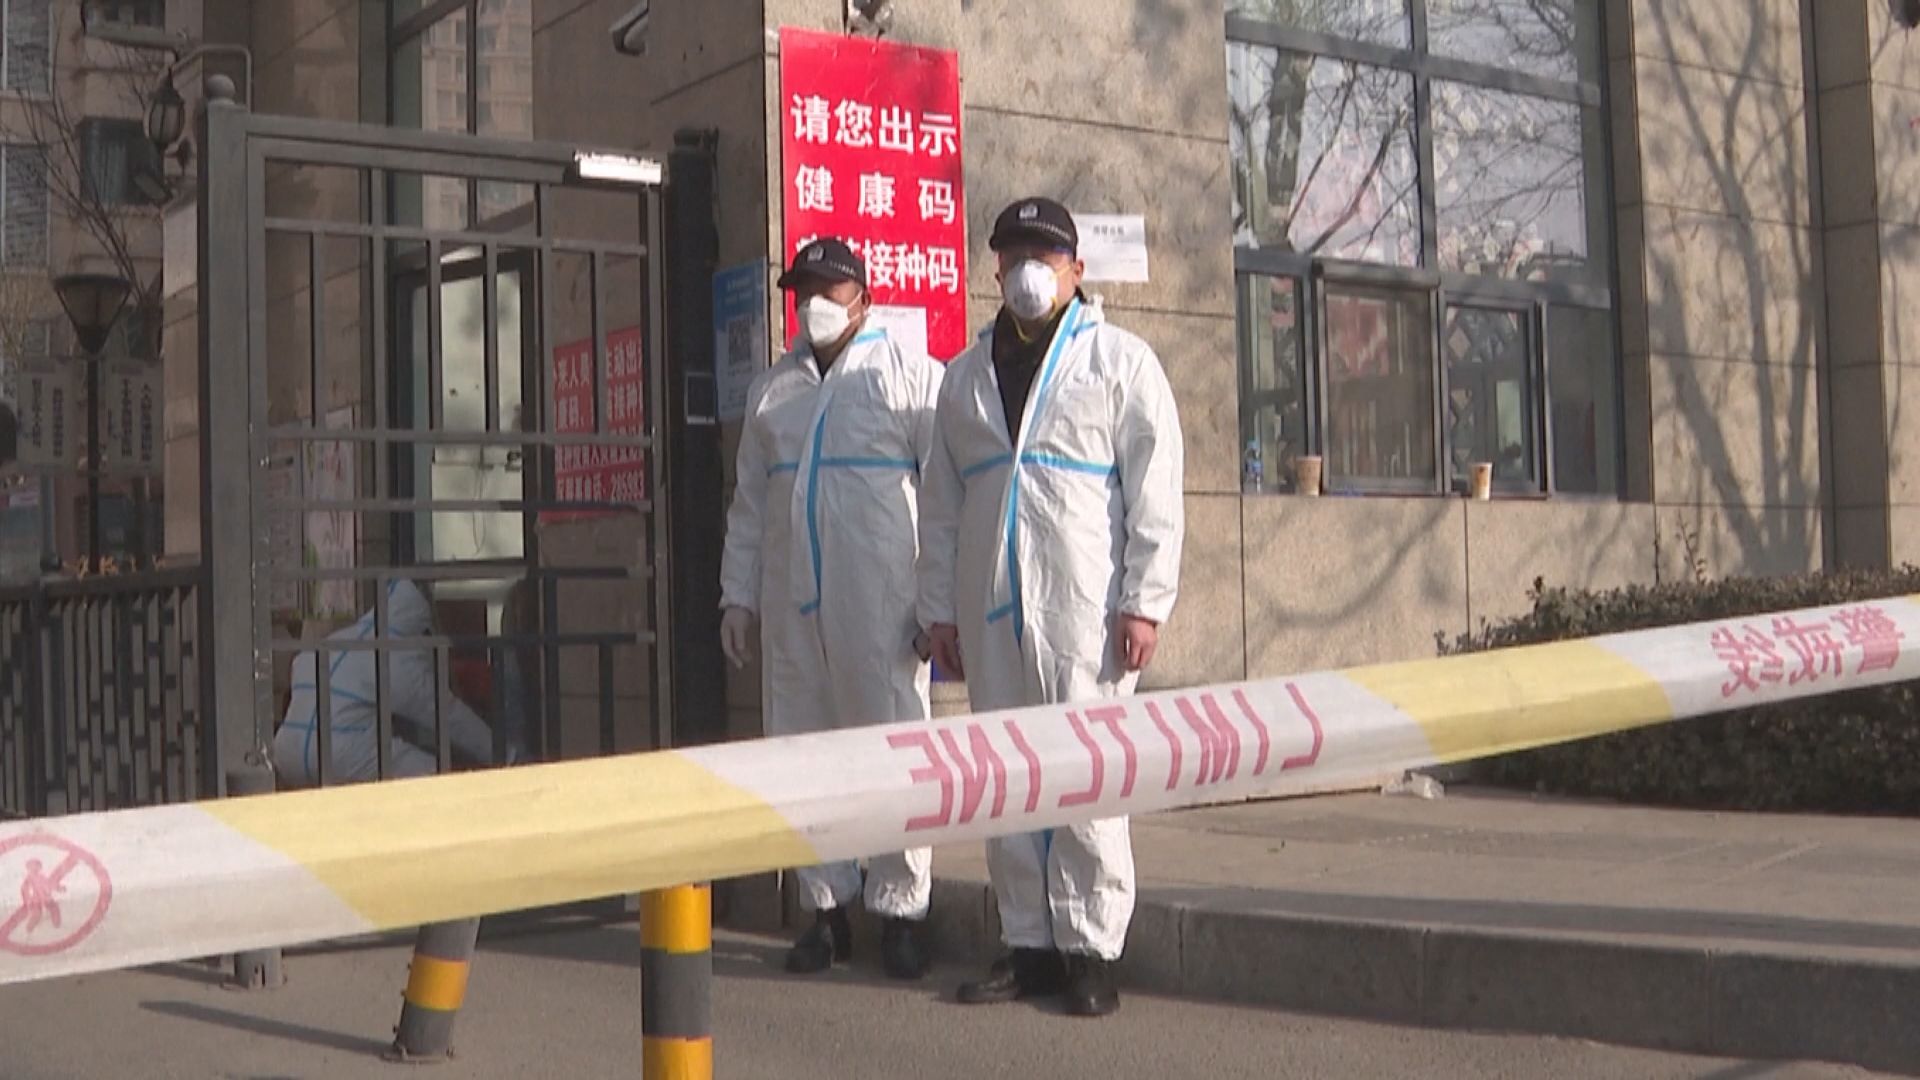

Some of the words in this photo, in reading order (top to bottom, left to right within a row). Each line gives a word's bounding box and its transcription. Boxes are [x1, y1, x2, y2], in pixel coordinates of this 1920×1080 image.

[790, 93, 957, 157] 请您出示
[795, 163, 955, 225] 健康码
[796, 232, 959, 294] 接种码
